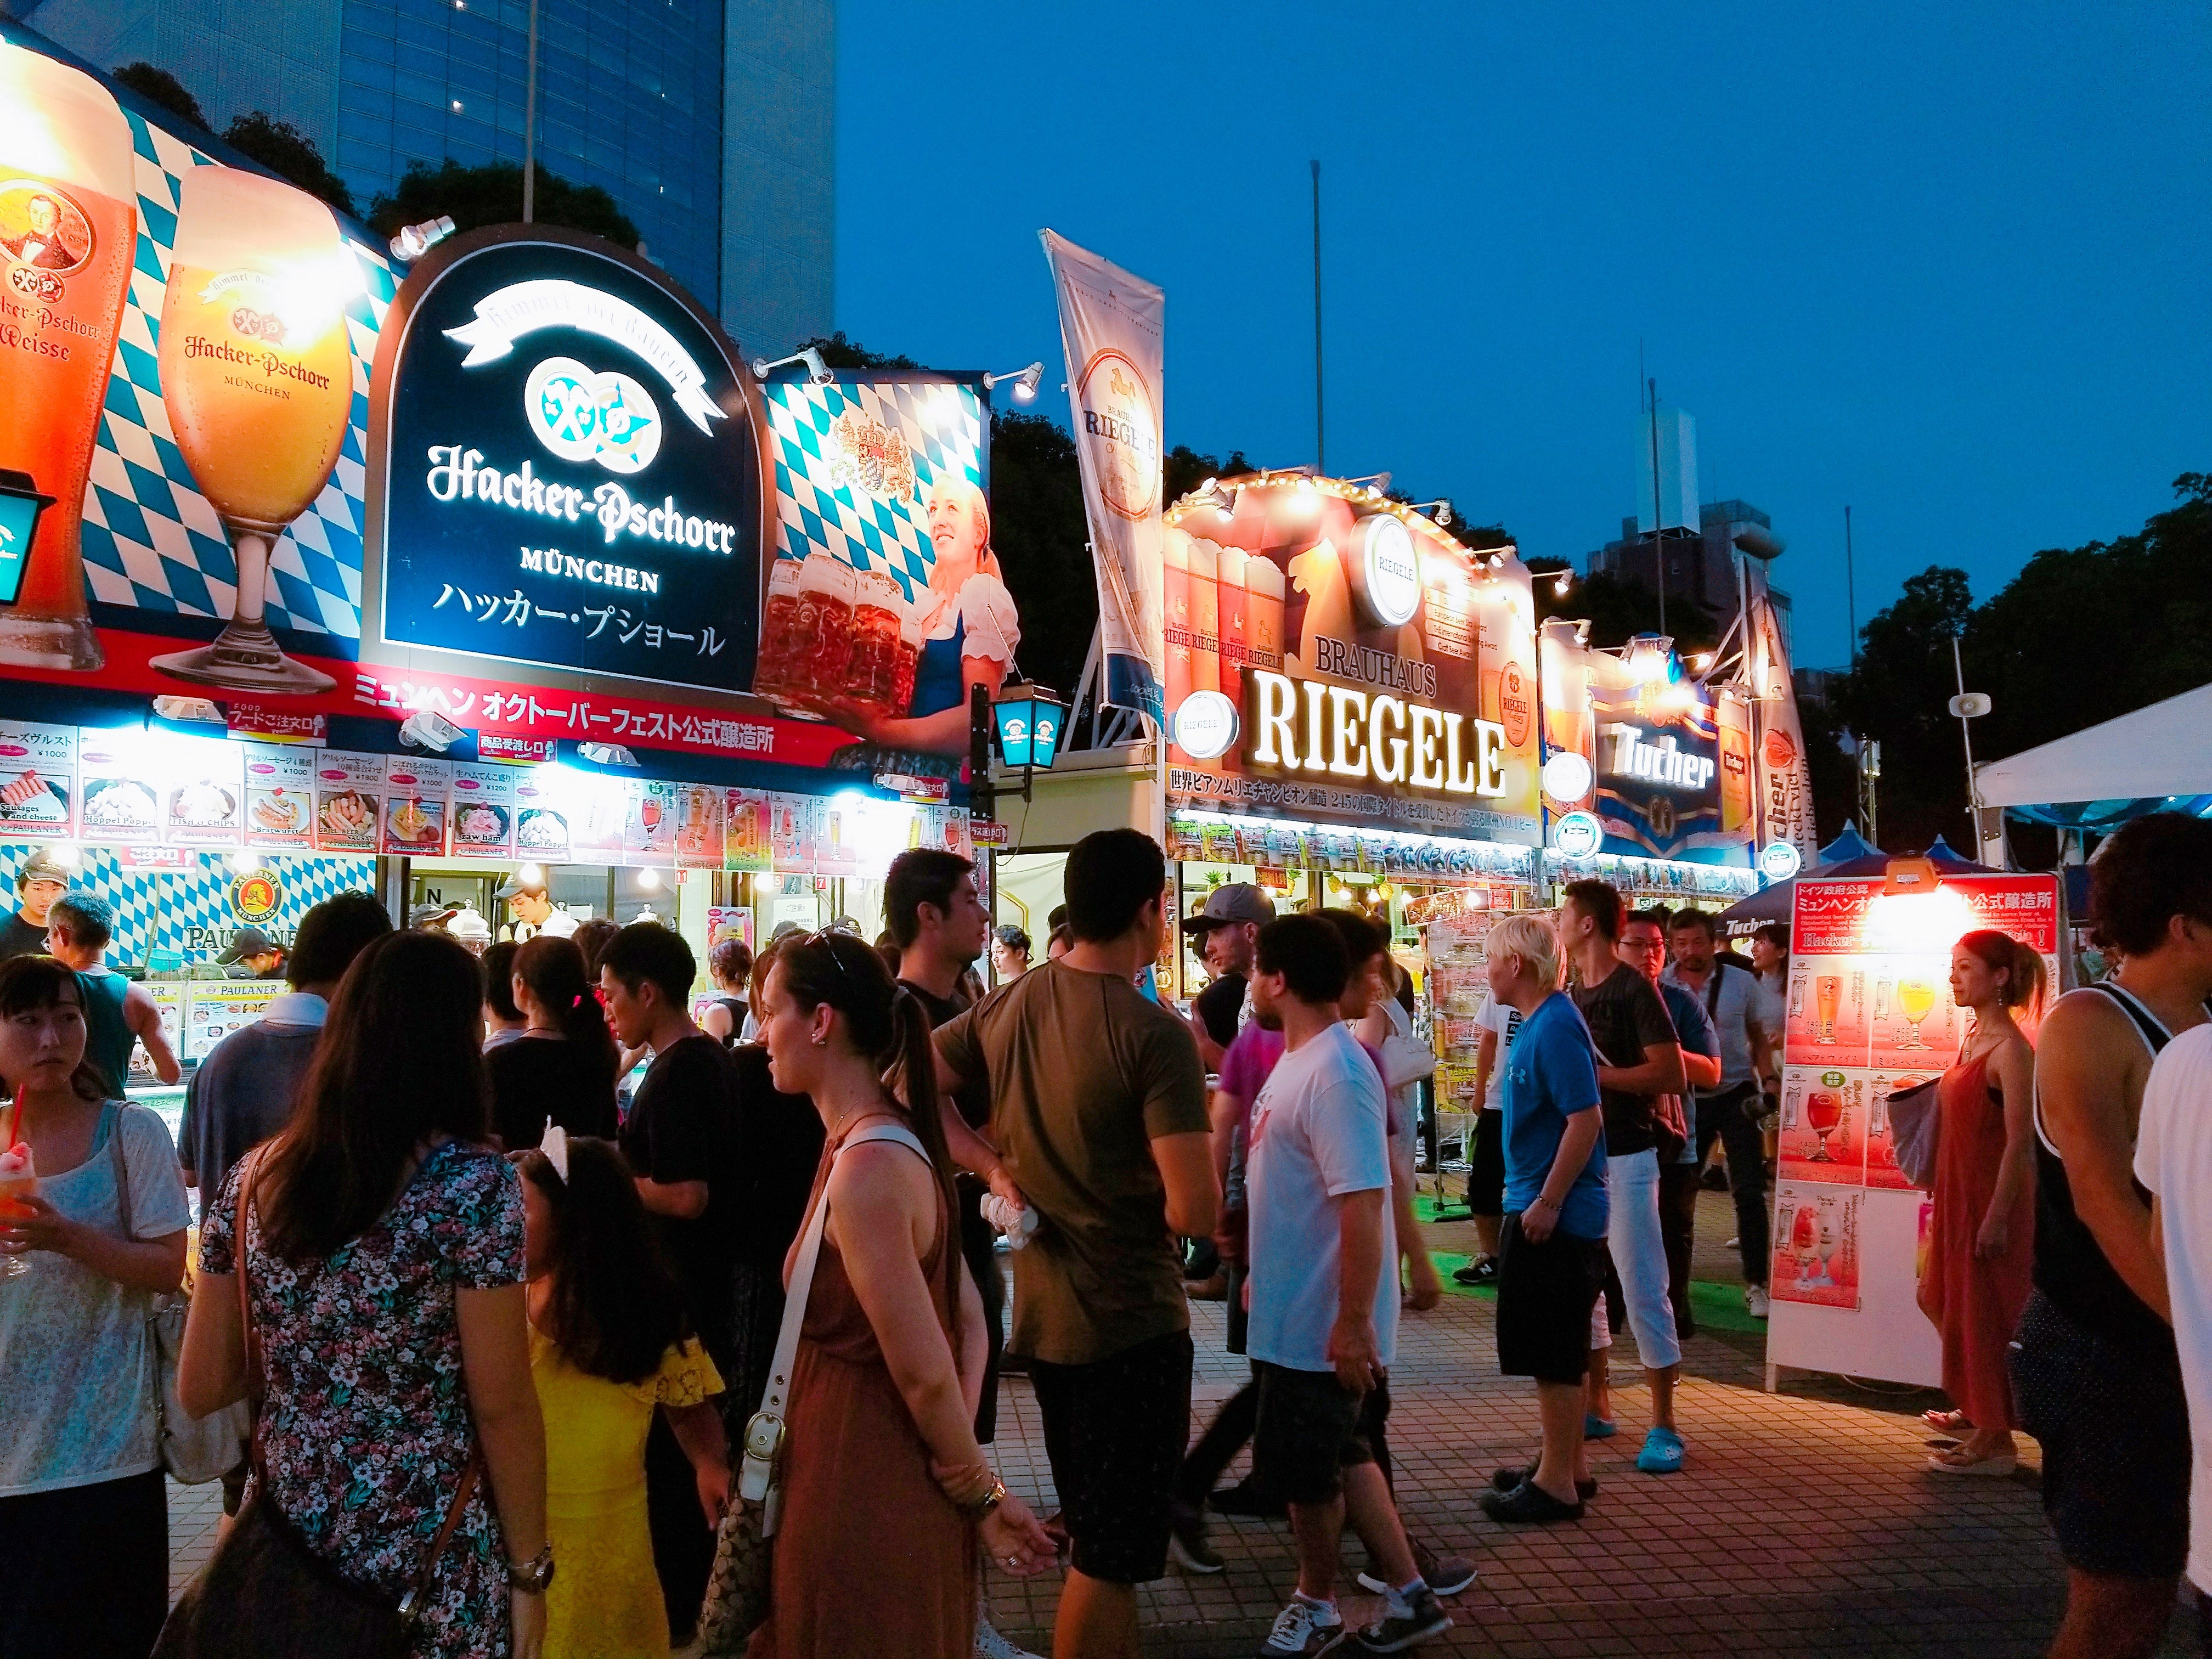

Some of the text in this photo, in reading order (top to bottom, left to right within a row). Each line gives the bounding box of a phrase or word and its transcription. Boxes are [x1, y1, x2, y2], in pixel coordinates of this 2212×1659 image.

[0, 323, 71, 362] Weisse
[185, 335, 330, 390] Hacker-Pschorr
[224, 375, 290, 399] MÜNCHEN
[426, 444, 736, 554] Hacker-Pschorr
[519, 546, 659, 594] MÜNCHEN
[1378, 556, 1414, 582] RIEGELE
[432, 583, 726, 657] ハッカー・プショール
[1315, 635, 1437, 698] BRAUHAUS
[234, 703, 261, 712] FOOD
[354, 673, 775, 754] ミュンヘン オクトーバーフェスト公式醸造所
[229, 710, 313, 730] フードご注文口
[1252, 669, 1506, 798] RIEGELE
[481, 735, 544, 754] 商品受渡し口
[38, 749, 67, 758] ¥1000
[1615, 722, 1716, 789] Tucher
[1725, 753, 1745, 769] Tucher
[283, 767, 308, 776] ¥1000
[455, 770, 511, 782] 生ハムてんこ盛り
[0, 803, 40, 812] Sausages
[85, 815, 120, 825] Hoppel
[256, 826, 298, 834] Bratwurst
[676, 871, 686, 882] 11
[775, 876, 782, 886] 5
[818, 878, 825, 889] 7
[1798, 884, 1869, 896] ドイツ政府公認
[221, 985, 278, 995] PAULANER
